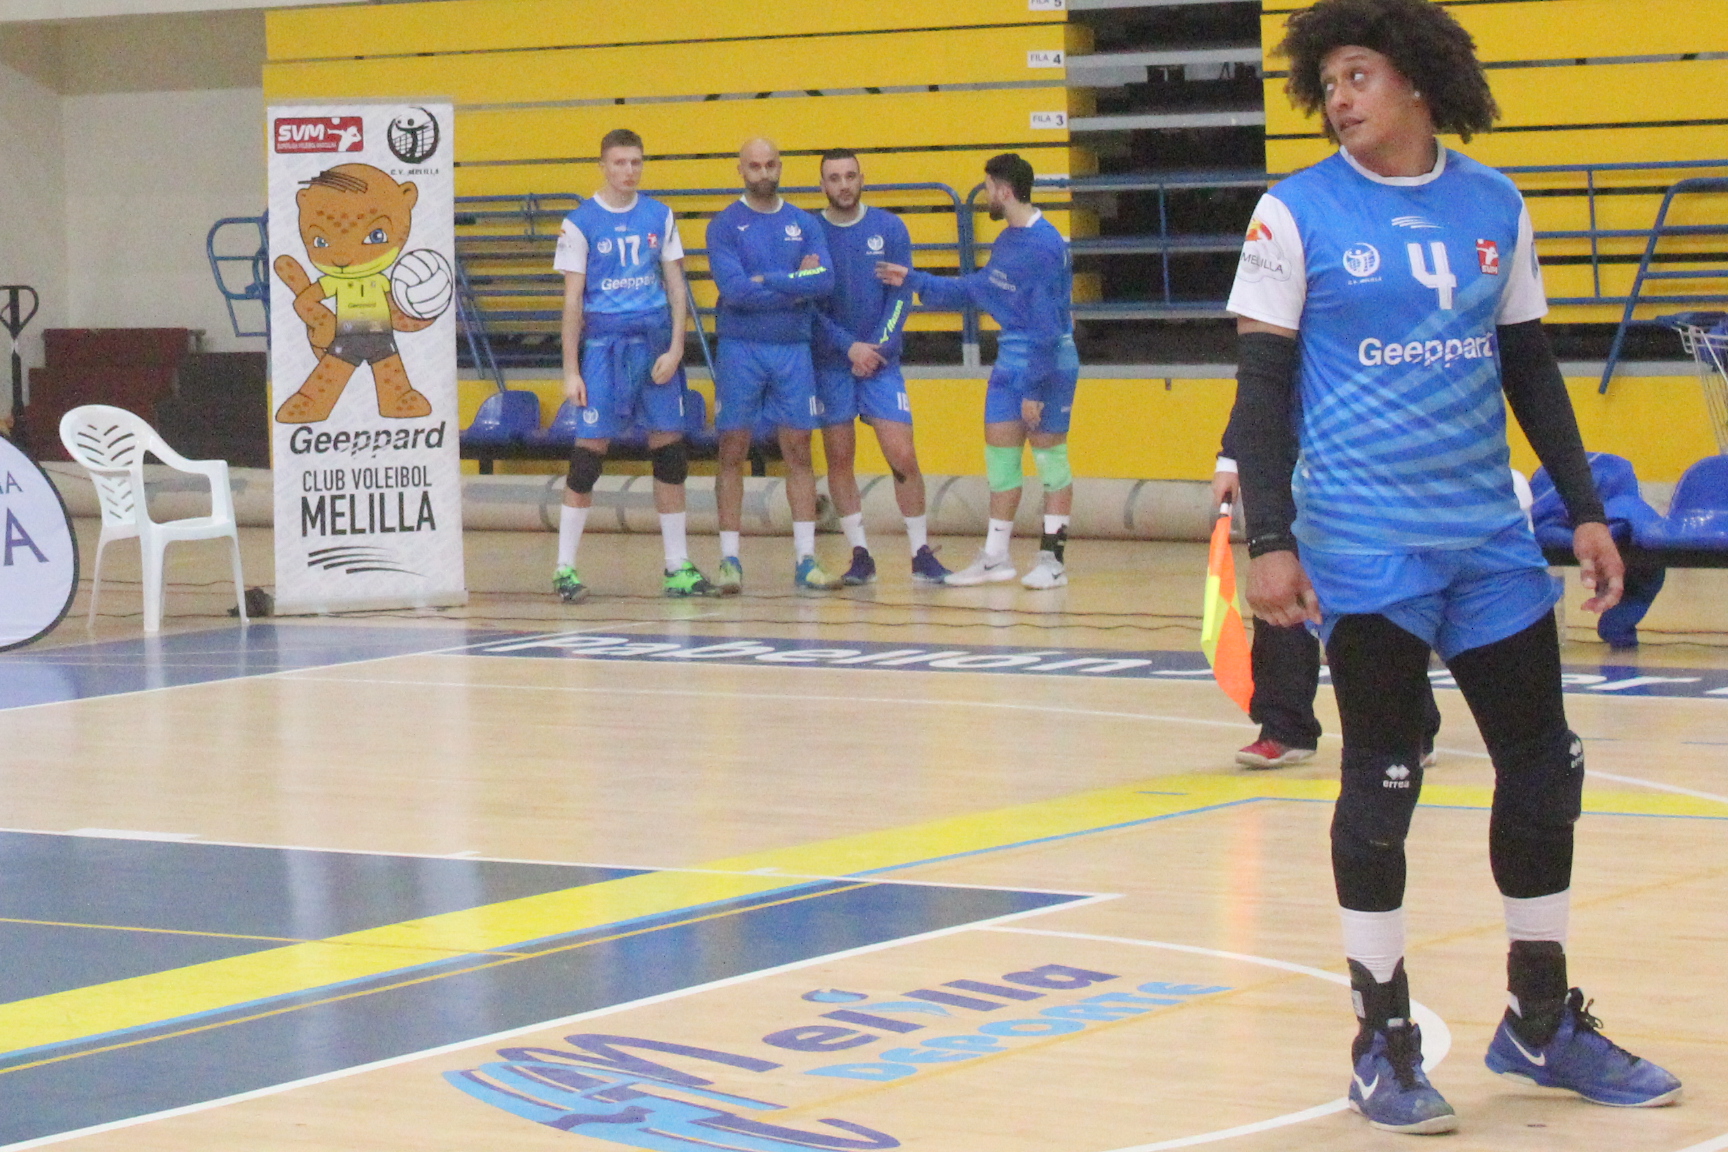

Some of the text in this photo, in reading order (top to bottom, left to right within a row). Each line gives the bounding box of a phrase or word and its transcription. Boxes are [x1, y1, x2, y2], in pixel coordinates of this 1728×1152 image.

[1030, 53, 1061, 65] FILA 4
[278, 123, 325, 141] SVM
[1032, 114, 1064, 126] FILA 3
[617, 234, 641, 267] 17
[601, 273, 656, 290] Geeppa
[1406, 241, 1458, 310] 4
[290, 421, 445, 458] Geeppard
[302, 465, 432, 493] CLUB VOLEIBOL
[301, 490, 437, 538] MELILLA
[494, 962, 1122, 1086] Melilla
[802, 980, 1234, 1084] DEPORTE
